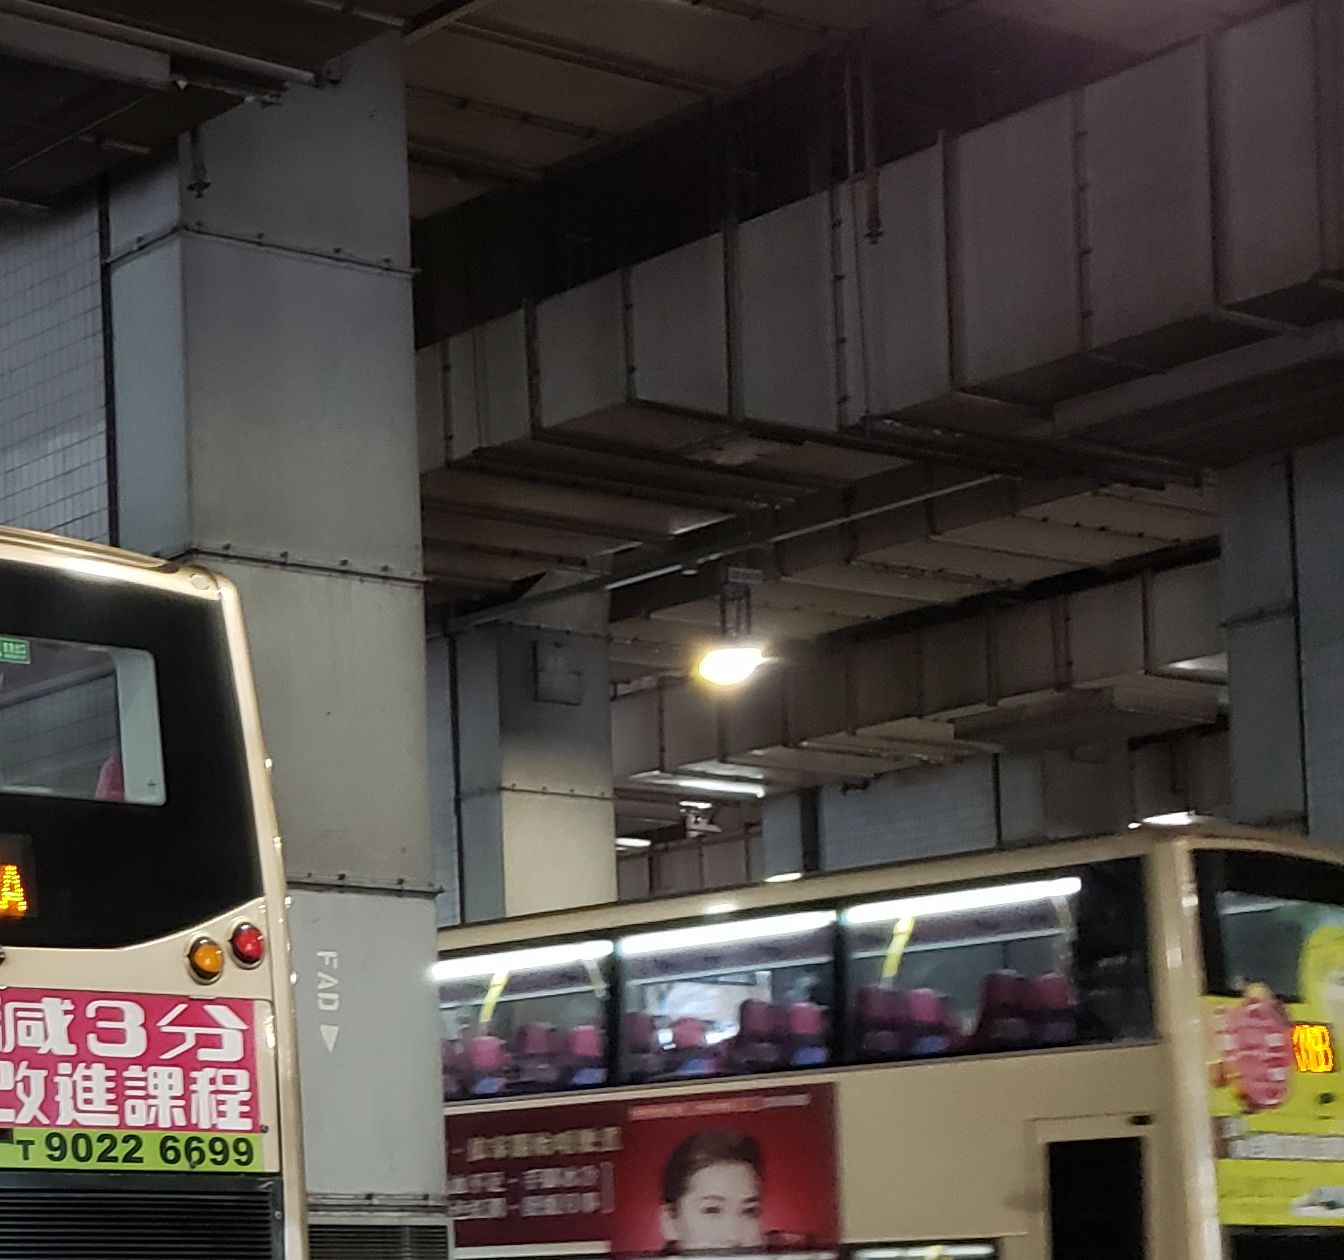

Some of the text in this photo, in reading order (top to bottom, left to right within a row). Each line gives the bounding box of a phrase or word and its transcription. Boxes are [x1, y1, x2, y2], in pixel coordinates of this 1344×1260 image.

[316, 951, 340, 1011] FAD
[16, 1132, 254, 1168] T 9022 6699
